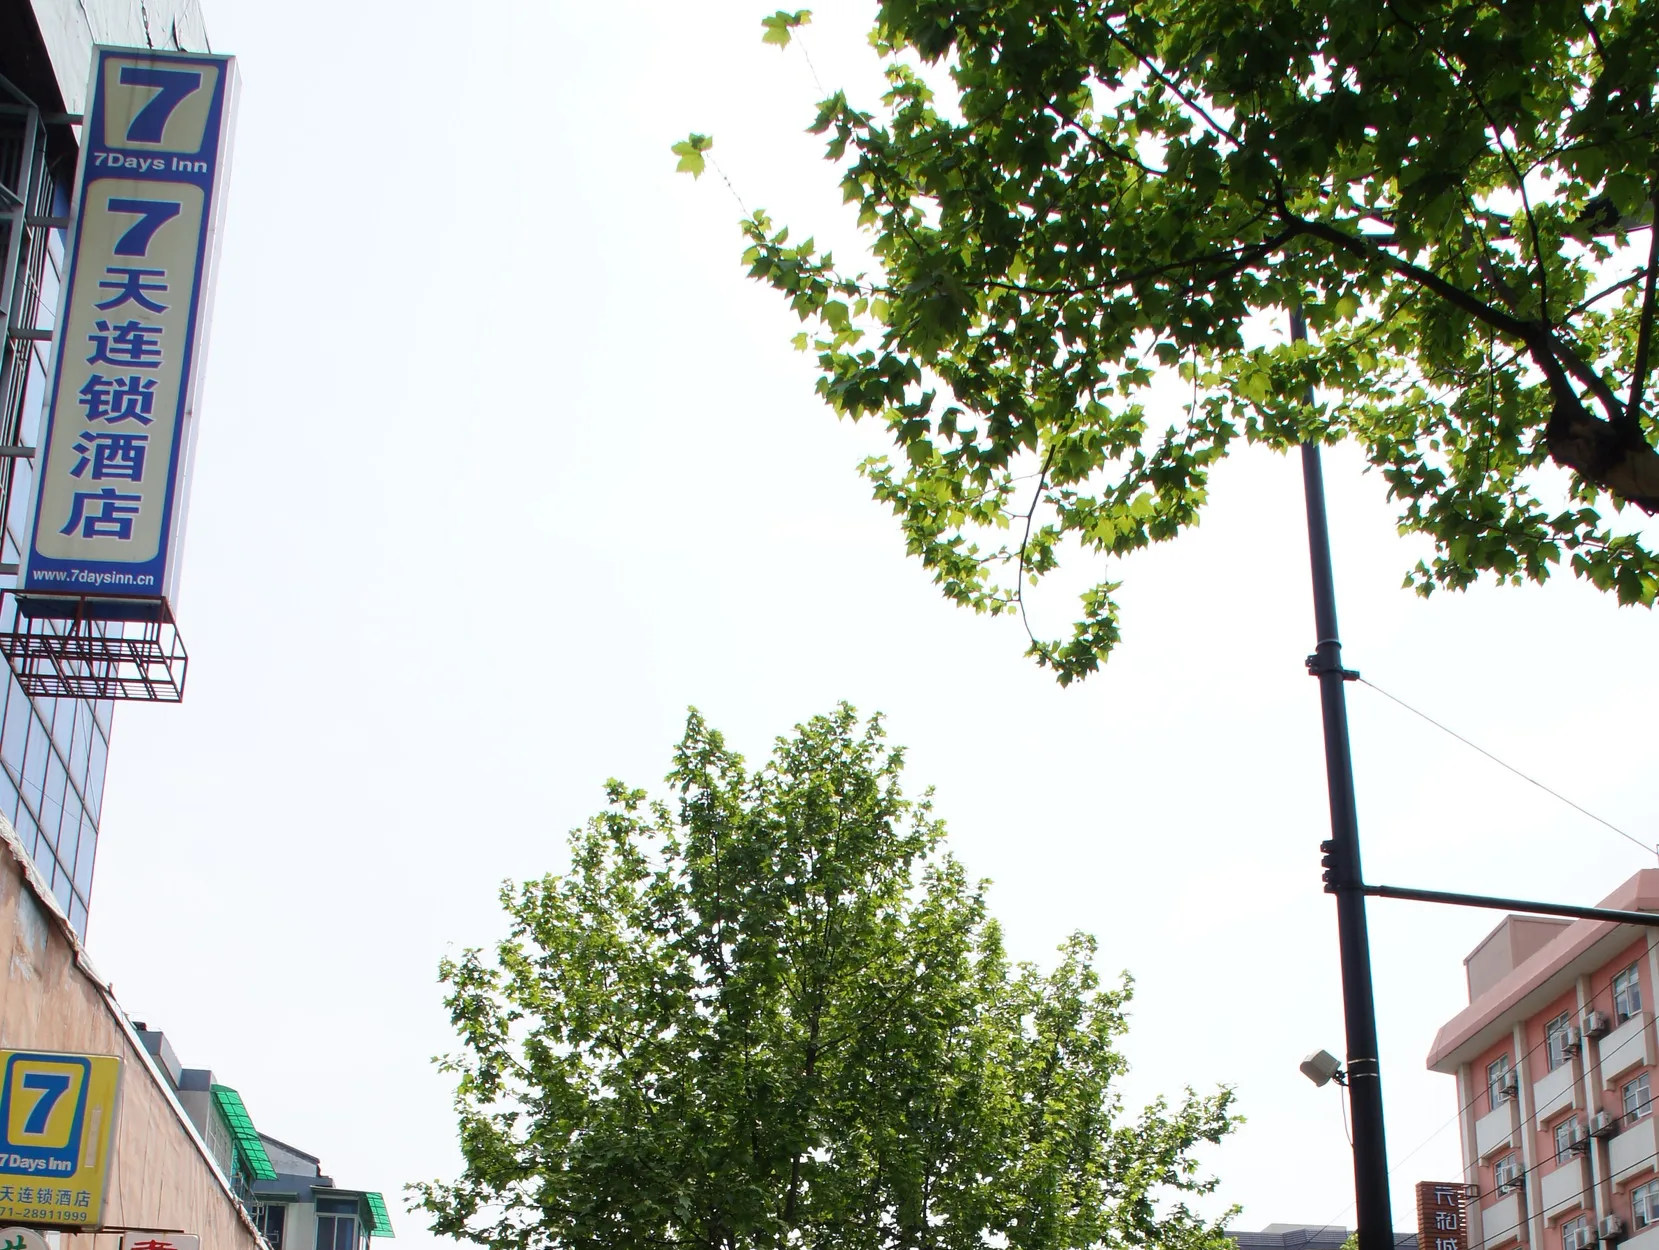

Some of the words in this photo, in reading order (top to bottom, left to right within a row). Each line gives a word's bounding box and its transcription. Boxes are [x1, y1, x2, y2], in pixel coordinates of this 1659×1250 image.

[119, 65, 203, 144] 7
[93, 152, 165, 173] 7Days
[171, 157, 208, 173] Inn
[59, 197, 183, 542] 7天连锁酒店
[32, 566, 155, 587] www.7daysinn.cn
[21, 1071, 72, 1136] 7
[48, 1157, 72, 1171] Inn
